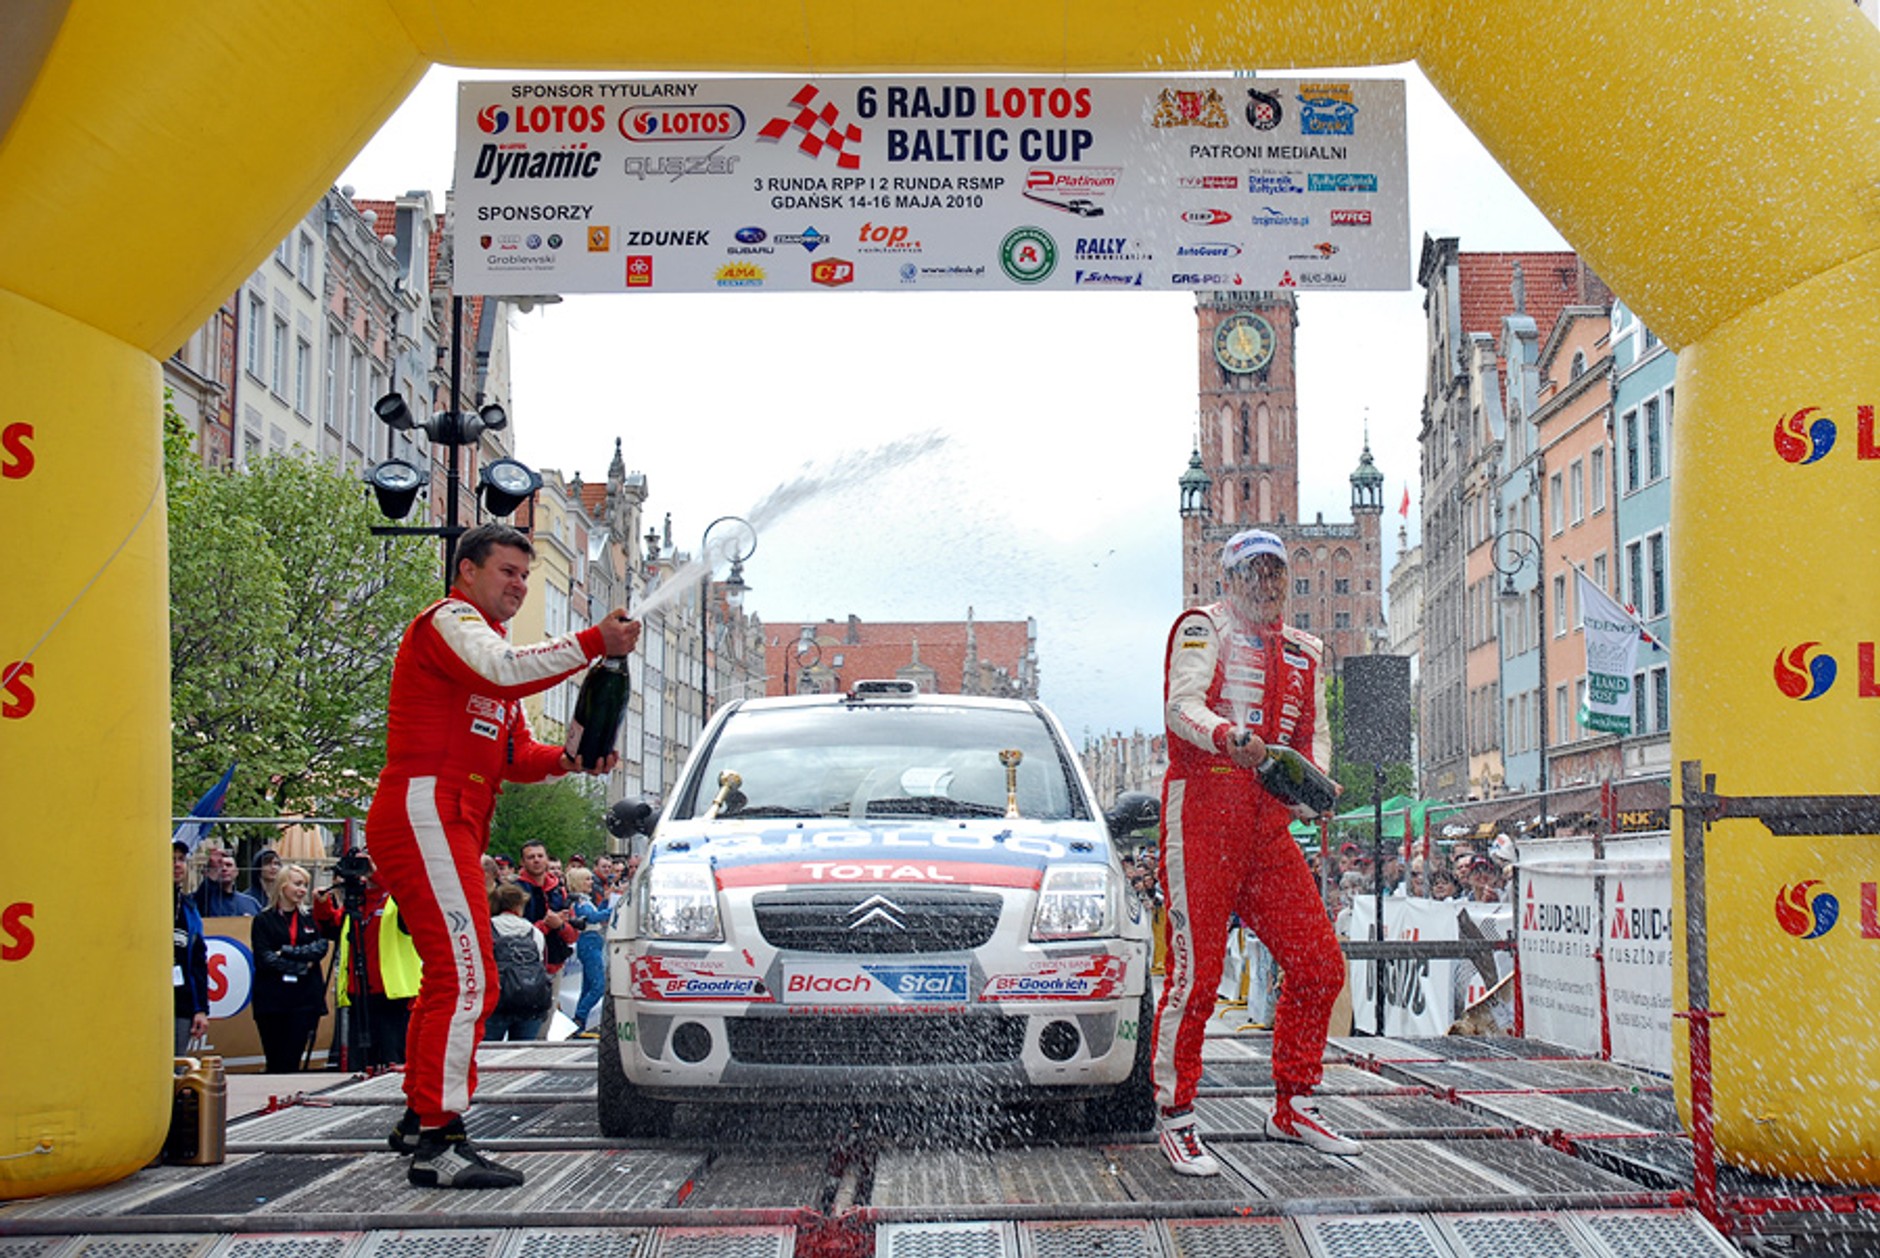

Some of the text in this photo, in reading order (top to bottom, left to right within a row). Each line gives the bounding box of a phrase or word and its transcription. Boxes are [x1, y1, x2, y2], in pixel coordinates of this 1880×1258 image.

[512, 84, 698, 98] SPONSOR TYTULARNY
[857, 86, 1092, 119] 6 RAJD LOTOS
[516, 105, 605, 133] LOTOS
[662, 113, 730, 133] LOTOS
[887, 128, 1094, 162] BALTIC CUP
[1190, 146, 1347, 160] PATRONI MEDIALNI
[474, 143, 602, 185] Dynamic
[754, 178, 763, 191] 3
[769, 178, 827, 191] RUNDA
[832, 178, 865, 191] RPP
[880, 178, 889, 191] 2
[894, 178, 952, 191] RUNDA
[957, 177, 1005, 190] RSMP
[1055, 175, 1115, 186] Platinum
[771, 192, 983, 209] GDAŃSK 14-16 MAJA 2010
[478, 205, 593, 221] SPONSORZY
[627, 230, 710, 246] ZDUNEK
[859, 222, 908, 248] top
[1076, 238, 1126, 254] RALLY
[802, 863, 954, 881] TOTAL
[1539, 903, 1591, 935] BUD-BAU
[788, 974, 953, 993] Blach Stal
[996, 977, 1088, 990] BFGoodrich
